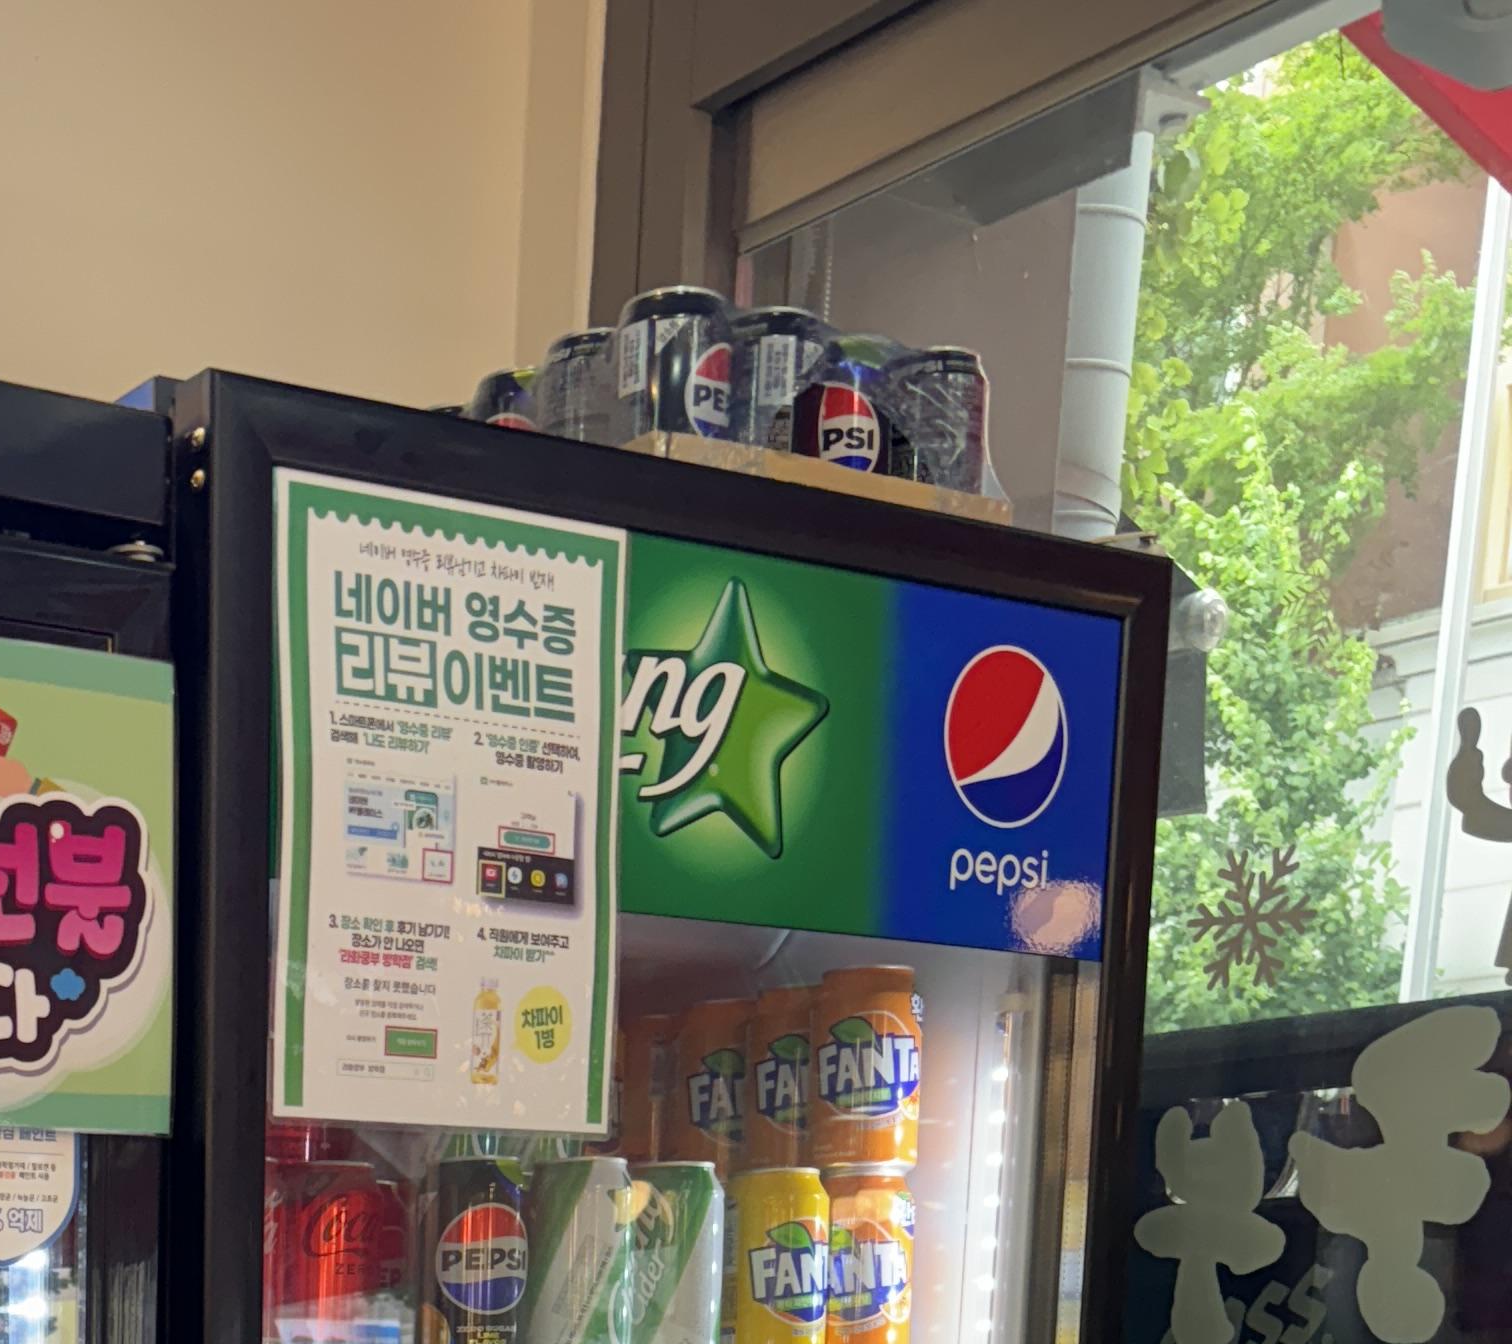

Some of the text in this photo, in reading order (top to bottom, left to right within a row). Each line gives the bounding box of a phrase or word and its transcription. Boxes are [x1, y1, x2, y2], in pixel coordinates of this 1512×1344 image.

[333, 570, 577, 656] 네이버 영수증
[950, 848, 1050, 896] pepsi
[521, 1005, 563, 1029] 차파이
[534, 1028, 555, 1050] 1병
[819, 1035, 921, 1098] FANTA
[8, 1207, 44, 1233] 억제
[441, 1247, 527, 1272] PEPSI
